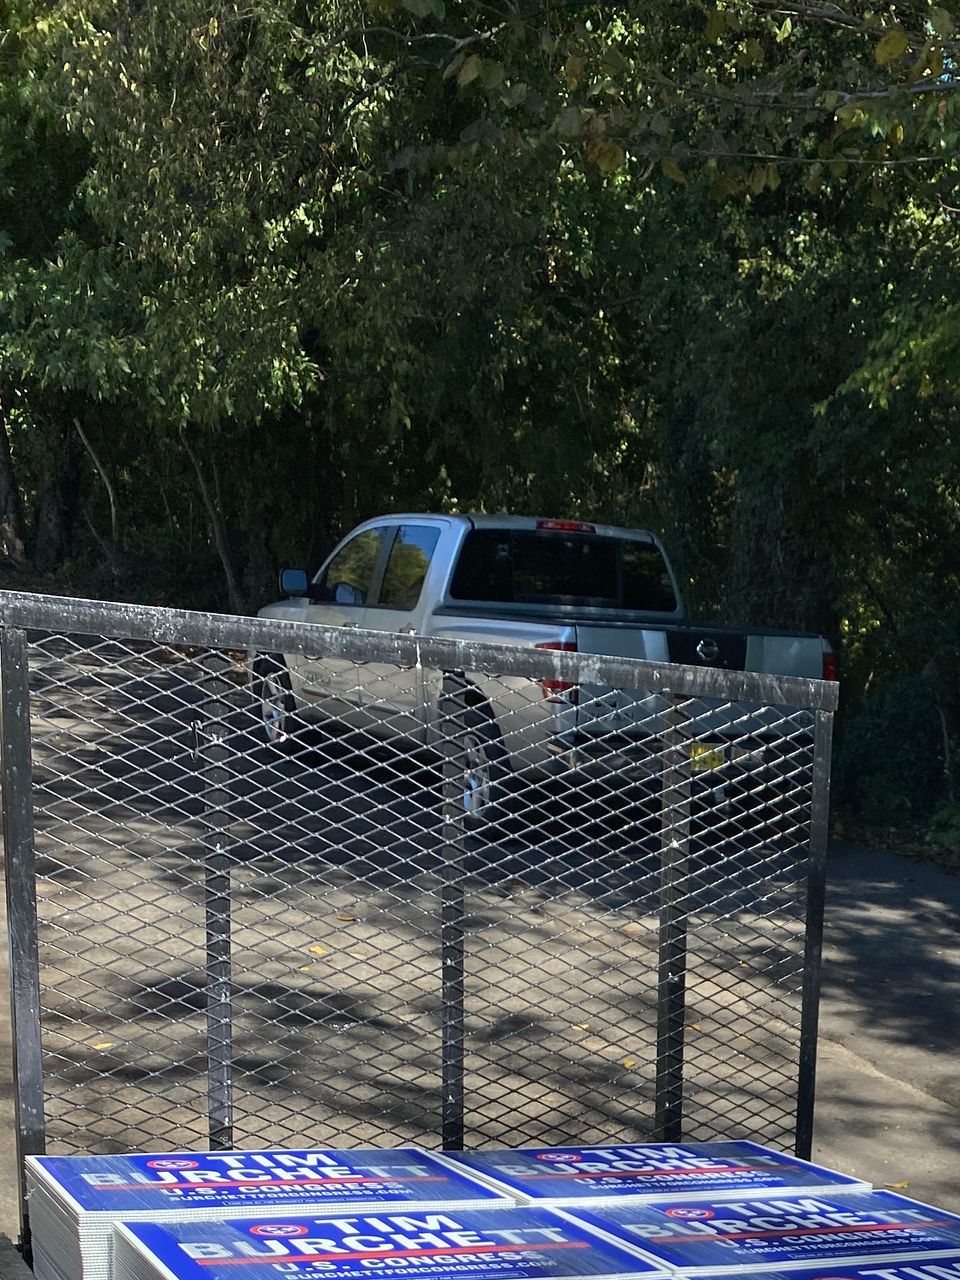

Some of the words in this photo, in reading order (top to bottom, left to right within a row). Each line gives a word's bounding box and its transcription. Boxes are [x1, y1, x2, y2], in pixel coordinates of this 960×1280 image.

[205, 1155, 337, 1167] TIM
[580, 1147, 695, 1159] TIM
[79, 1165, 428, 1185] BURCHETT
[493, 1156, 781, 1176] BURCHETT
[239, 1182, 402, 1192] CONGRESS
[710, 1199, 837, 1215] TIM
[314, 1215, 462, 1233] TIM
[621, 1209, 934, 1238] BURCHETT
[178, 1228, 568, 1259] BURCHETT
[782, 1229, 926, 1243] CONGRESS
[272, 1261, 350, 1271] U.S.
[360, 1251, 544, 1267] CONGRESS
